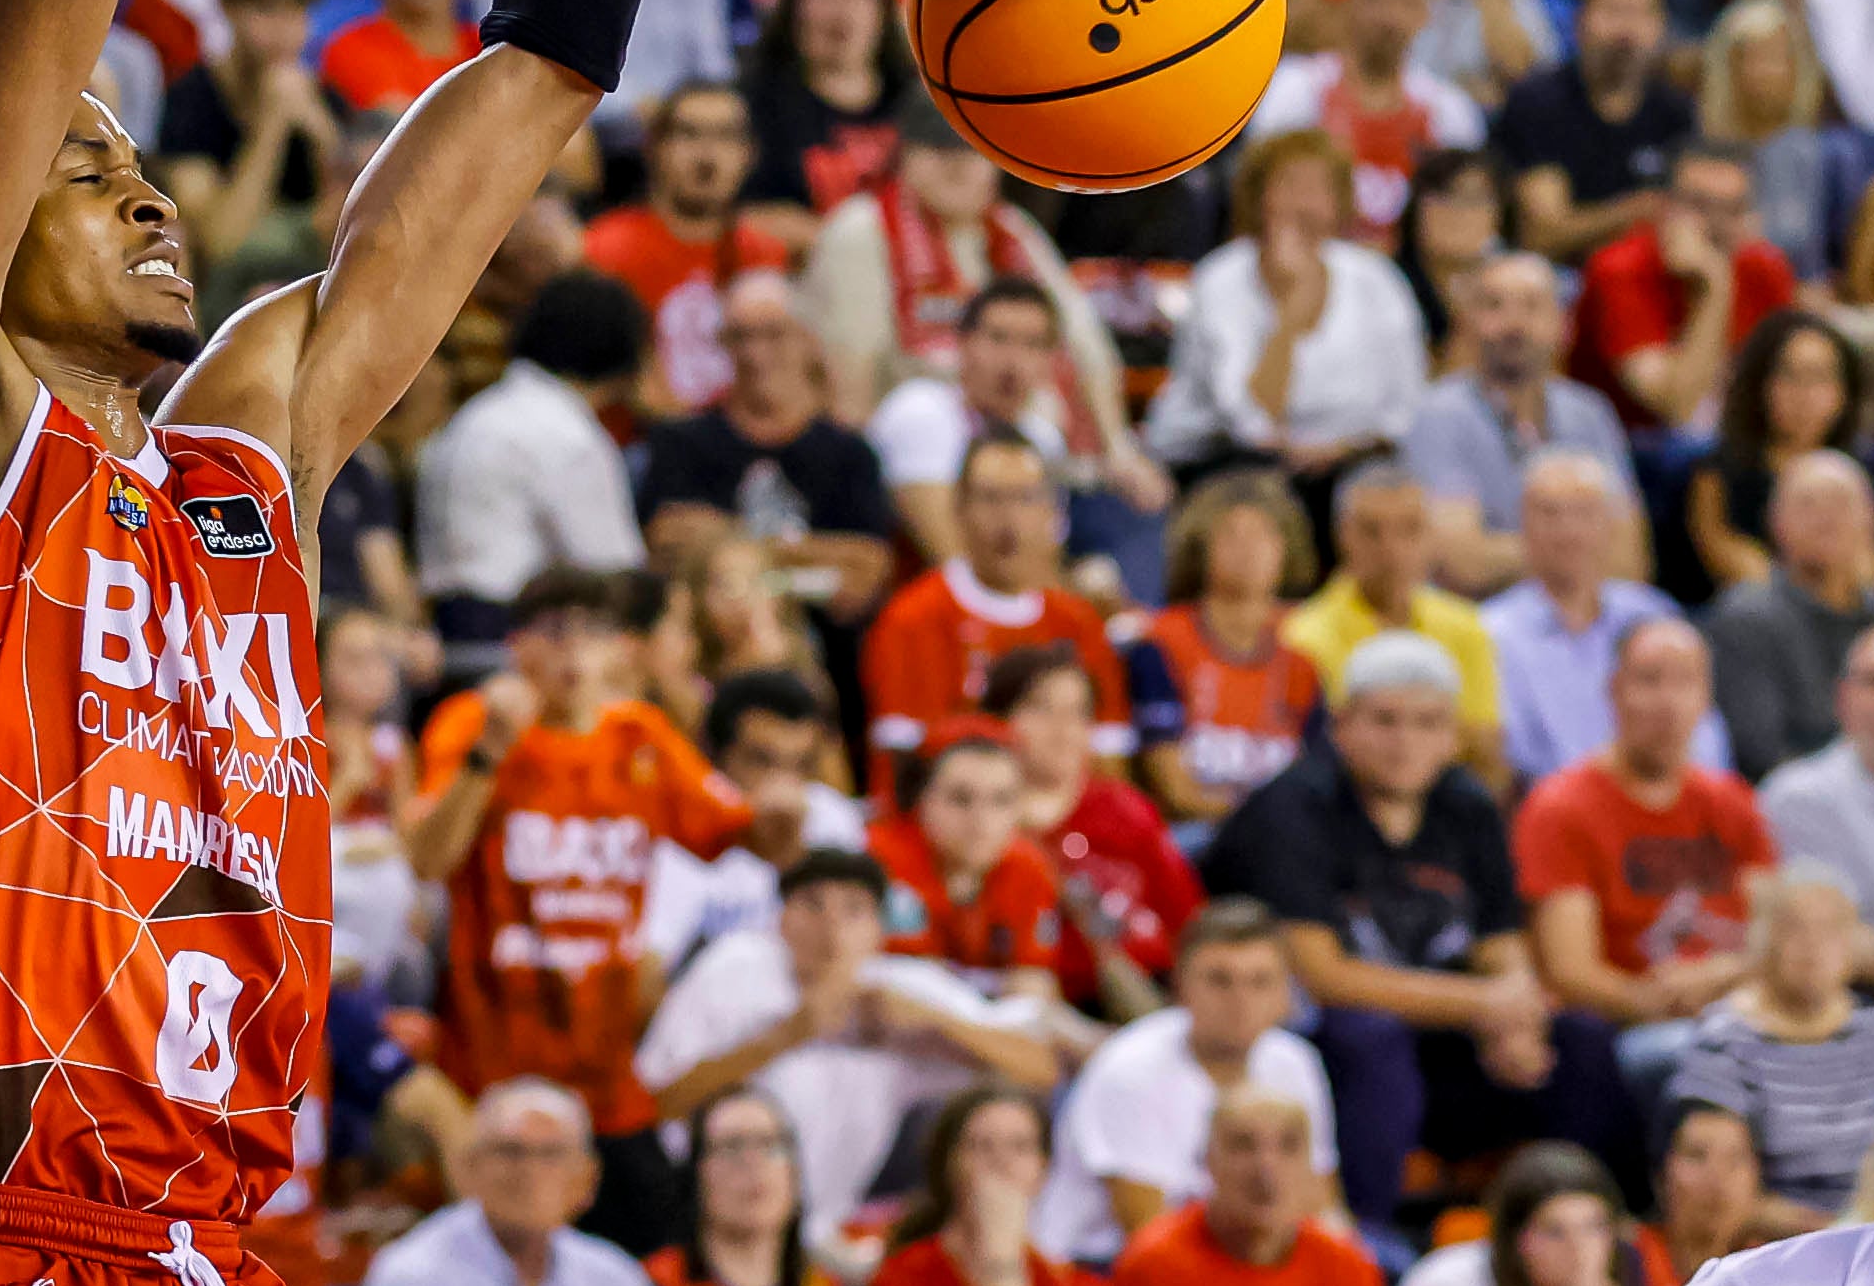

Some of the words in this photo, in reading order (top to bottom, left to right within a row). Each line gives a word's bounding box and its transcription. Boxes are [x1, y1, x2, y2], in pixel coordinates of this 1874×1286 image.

[197, 516, 226, 534] liga
[207, 532, 267, 550] endesa
[80, 547, 309, 738] BAXI
[155, 950, 244, 1104] 0
